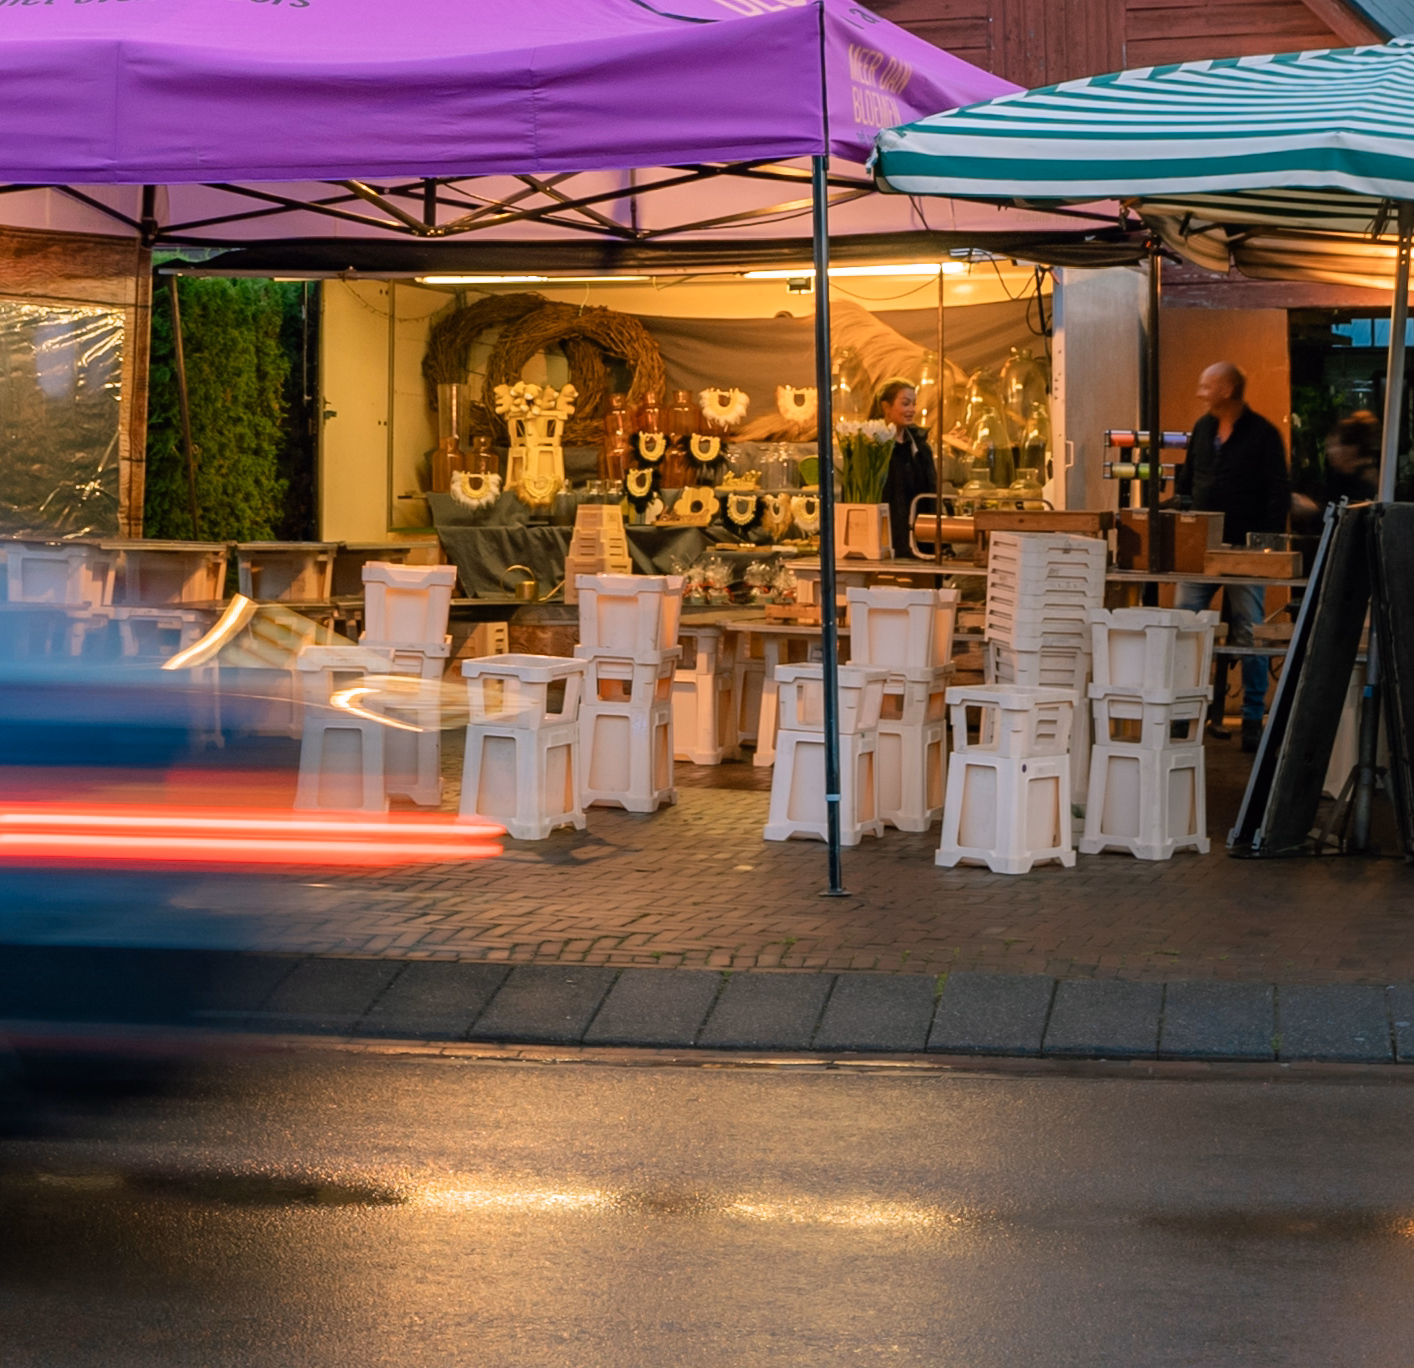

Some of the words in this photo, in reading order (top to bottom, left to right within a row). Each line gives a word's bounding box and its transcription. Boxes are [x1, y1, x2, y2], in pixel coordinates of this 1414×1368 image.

[848, 43, 884, 88] MEER
[879, 56, 913, 95] DAN
[851, 85, 902, 129] BLOEMEN
